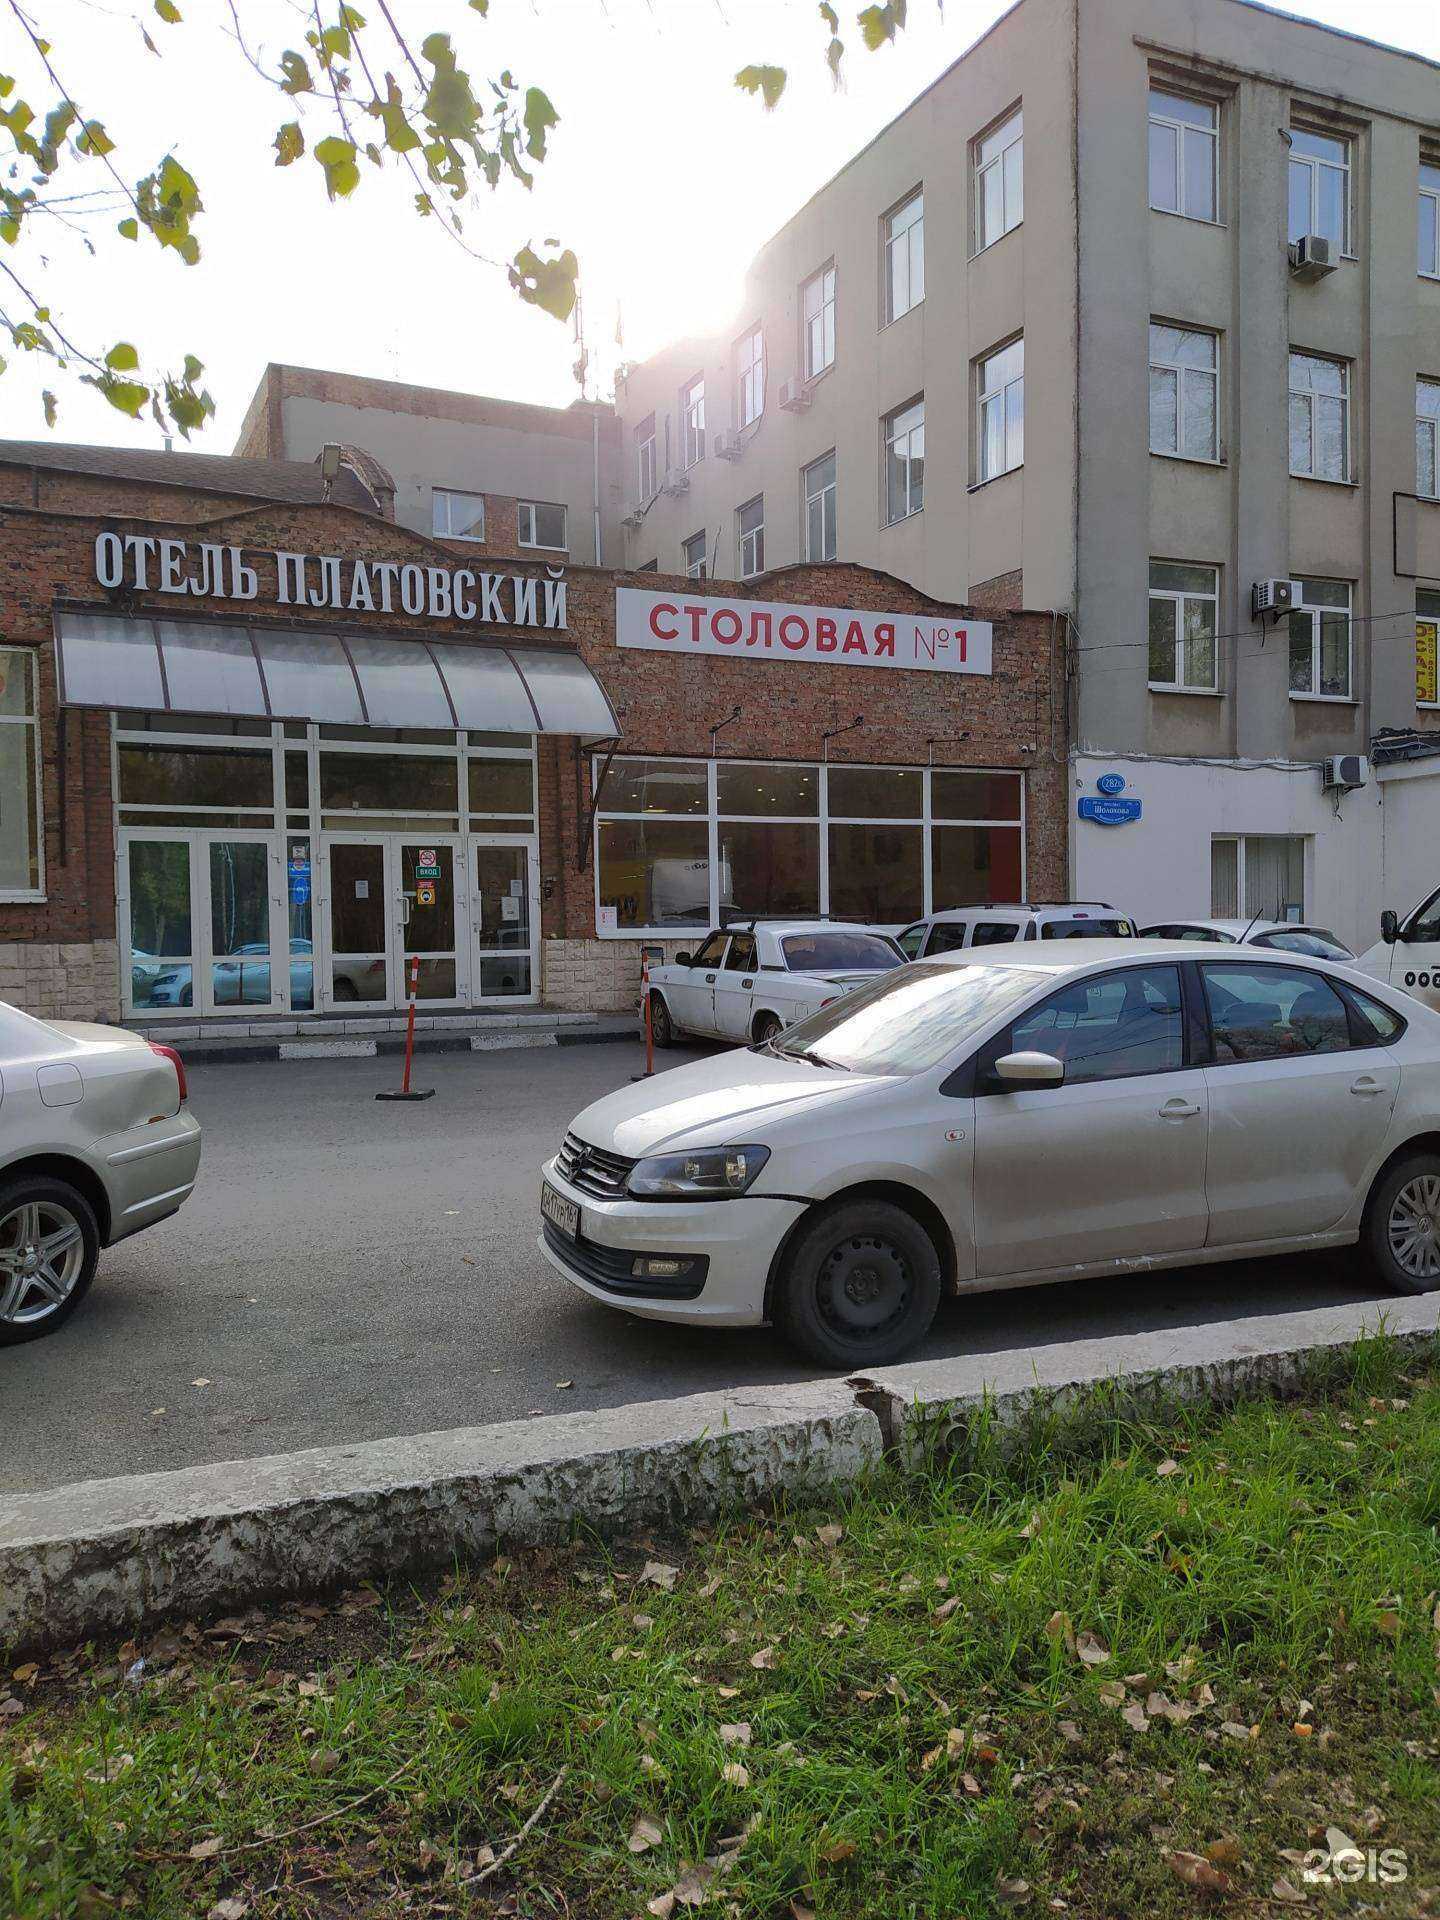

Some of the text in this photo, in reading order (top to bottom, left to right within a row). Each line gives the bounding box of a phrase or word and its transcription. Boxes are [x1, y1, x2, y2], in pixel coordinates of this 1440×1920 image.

[94, 532, 569, 631] ОТЕЛЬ ПЛАТОВСКИЙ
[649, 603, 896, 657] СТОЛОВАЯ
